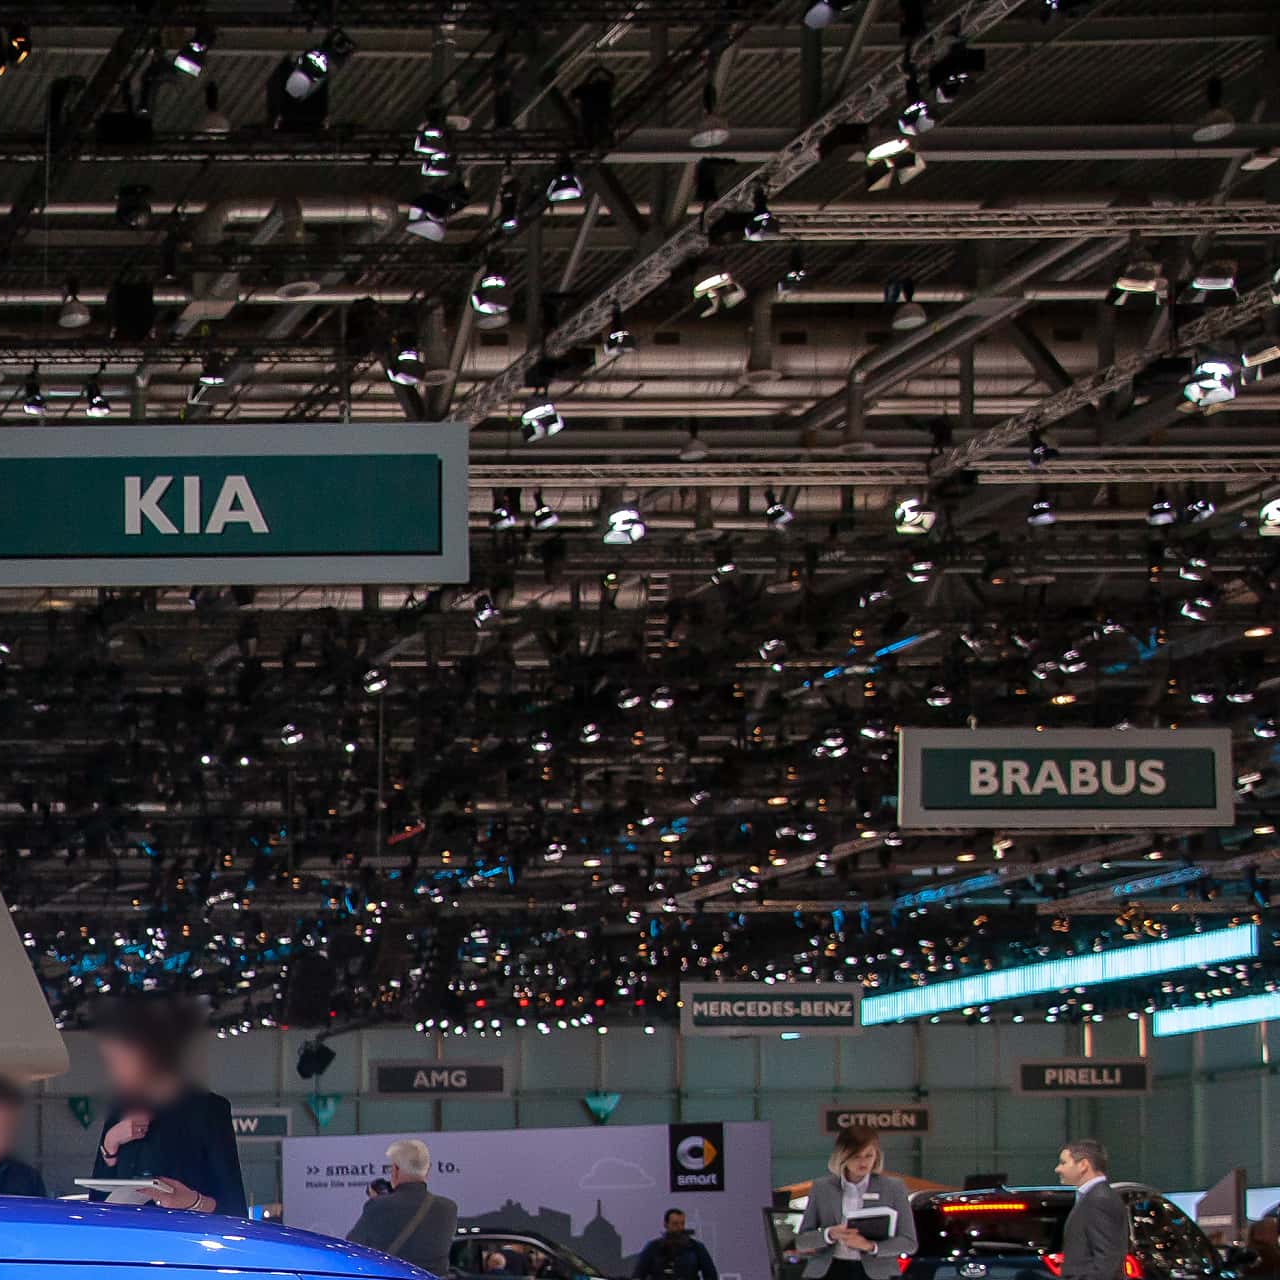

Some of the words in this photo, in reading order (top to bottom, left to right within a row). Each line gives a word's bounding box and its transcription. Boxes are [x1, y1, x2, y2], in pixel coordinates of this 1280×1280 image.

[124, 474, 270, 536] KIA
[969, 759, 1167, 796] BRABUS
[692, 1000, 853, 1018] MERCEDES-BENZ
[413, 1069, 467, 1089] AMG
[1044, 1067, 1122, 1086] PIRELLI
[836, 1109, 917, 1129] CITROËN
[325, 1162, 376, 1177] smart
[677, 1173, 718, 1186] smart
